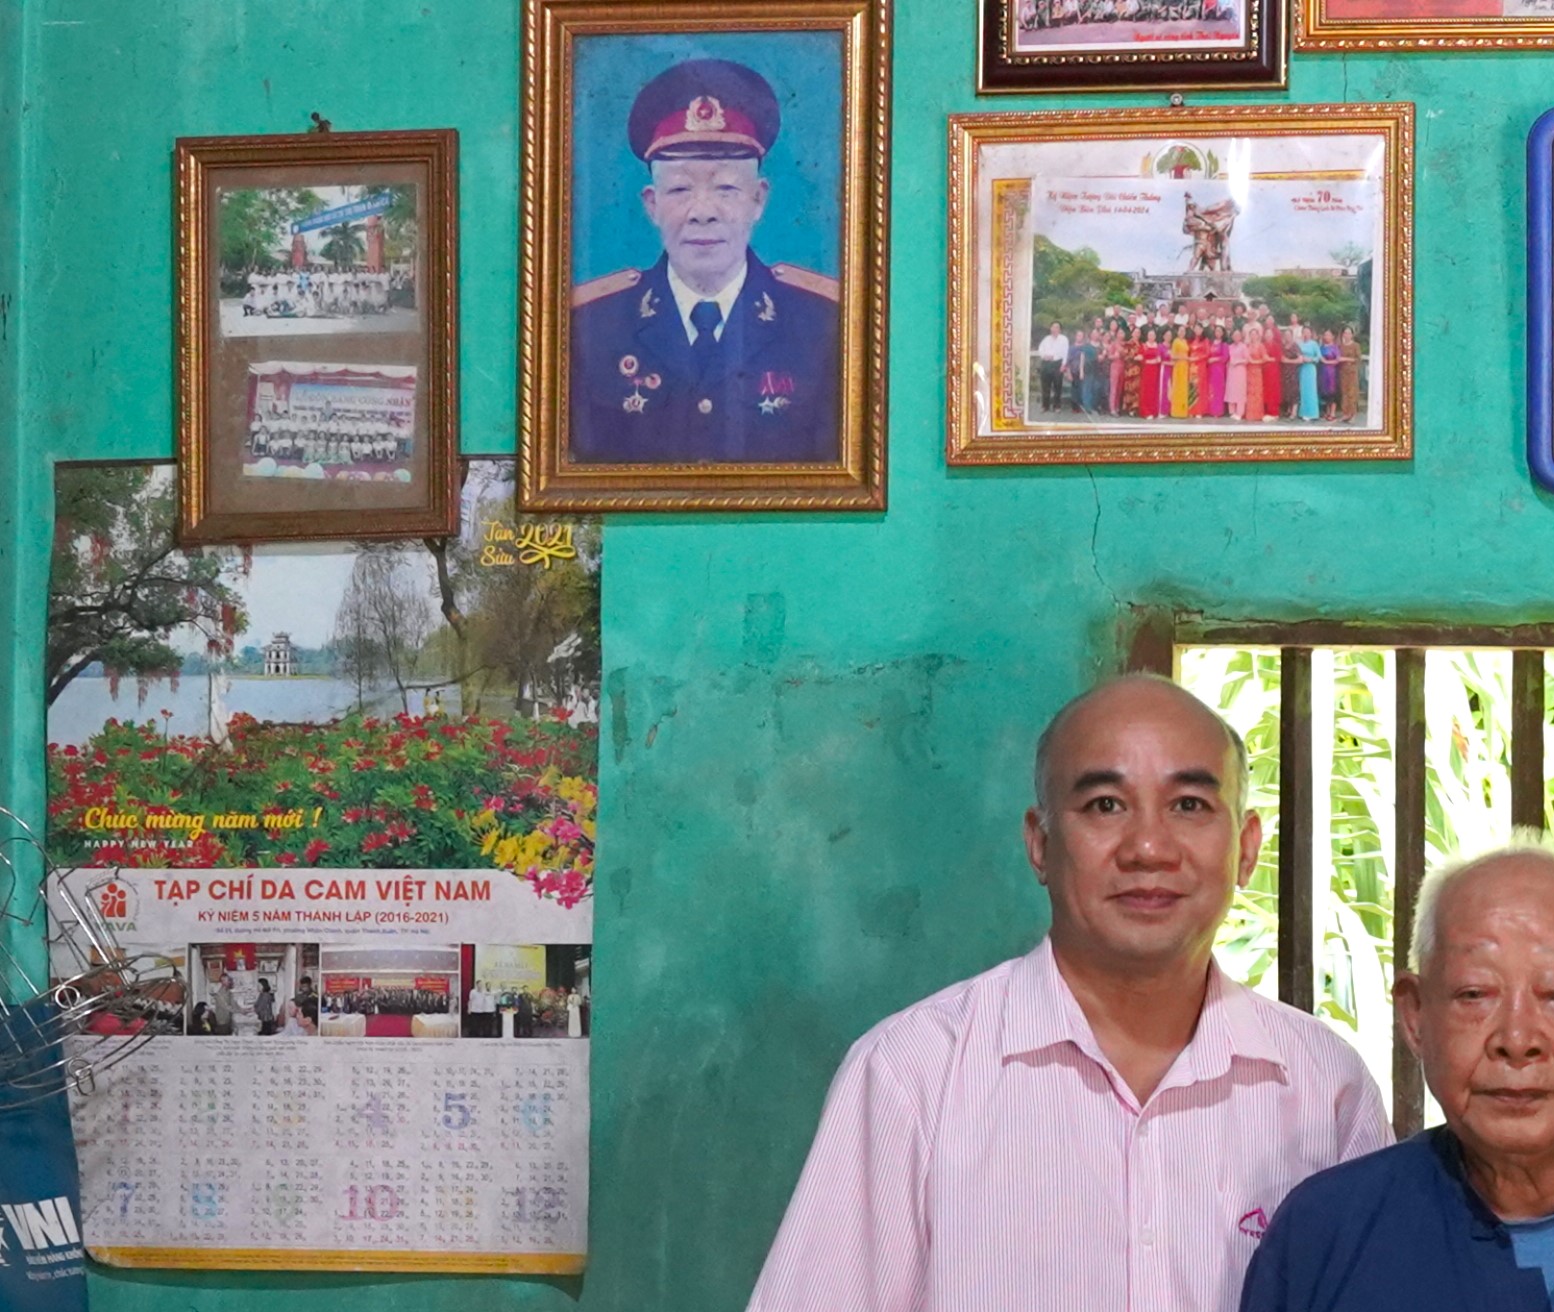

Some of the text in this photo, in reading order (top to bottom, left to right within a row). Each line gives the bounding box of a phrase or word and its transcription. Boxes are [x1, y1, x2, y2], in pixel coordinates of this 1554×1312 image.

[1317, 190, 1331, 203] 70
[515, 522, 575, 558] 2021
[84, 807, 138, 829] Chúc
[145, 810, 206, 840] mừng
[213, 811, 258, 829] năm
[263, 808, 304, 829] mới
[84, 840, 194, 849] HAPPY NEW YEAR
[154, 874, 490, 907] TẠP CHÍ DA CAM VIỆT NAM
[252, 911, 260, 921] 5
[375, 912, 448, 925] (2016-2021)
[442, 1092, 470, 1129] 5
[342, 1184, 400, 1222] 10
